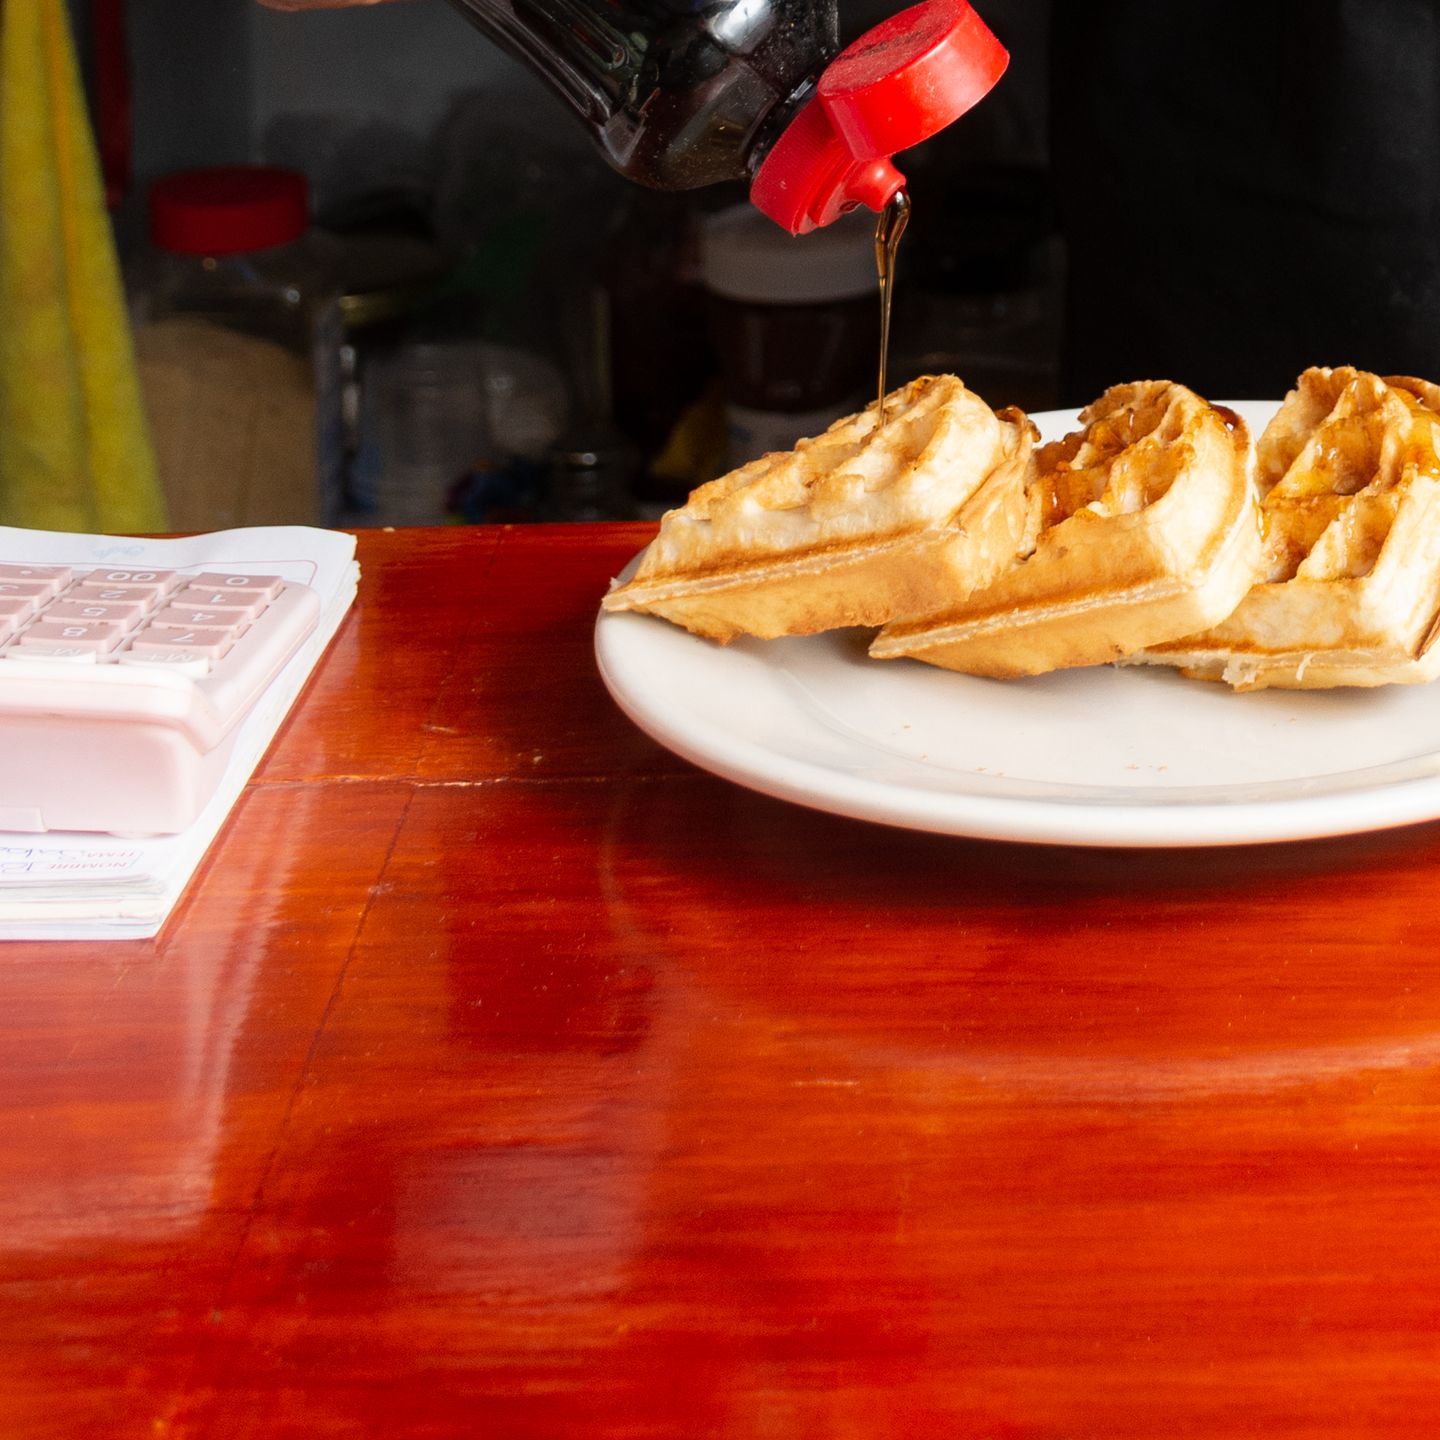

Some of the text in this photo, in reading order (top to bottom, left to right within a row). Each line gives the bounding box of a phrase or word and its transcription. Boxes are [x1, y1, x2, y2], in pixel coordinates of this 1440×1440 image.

[106, 571, 157, 582] 00
[225, 575, 250, 586] 0
[100, 589, 127, 600] 2
[208, 593, 227, 605] 1
[82, 606, 108, 618] 5
[190, 611, 216, 622] 4
[62, 626, 89, 638] 8
[171, 631, 196, 643] 7
